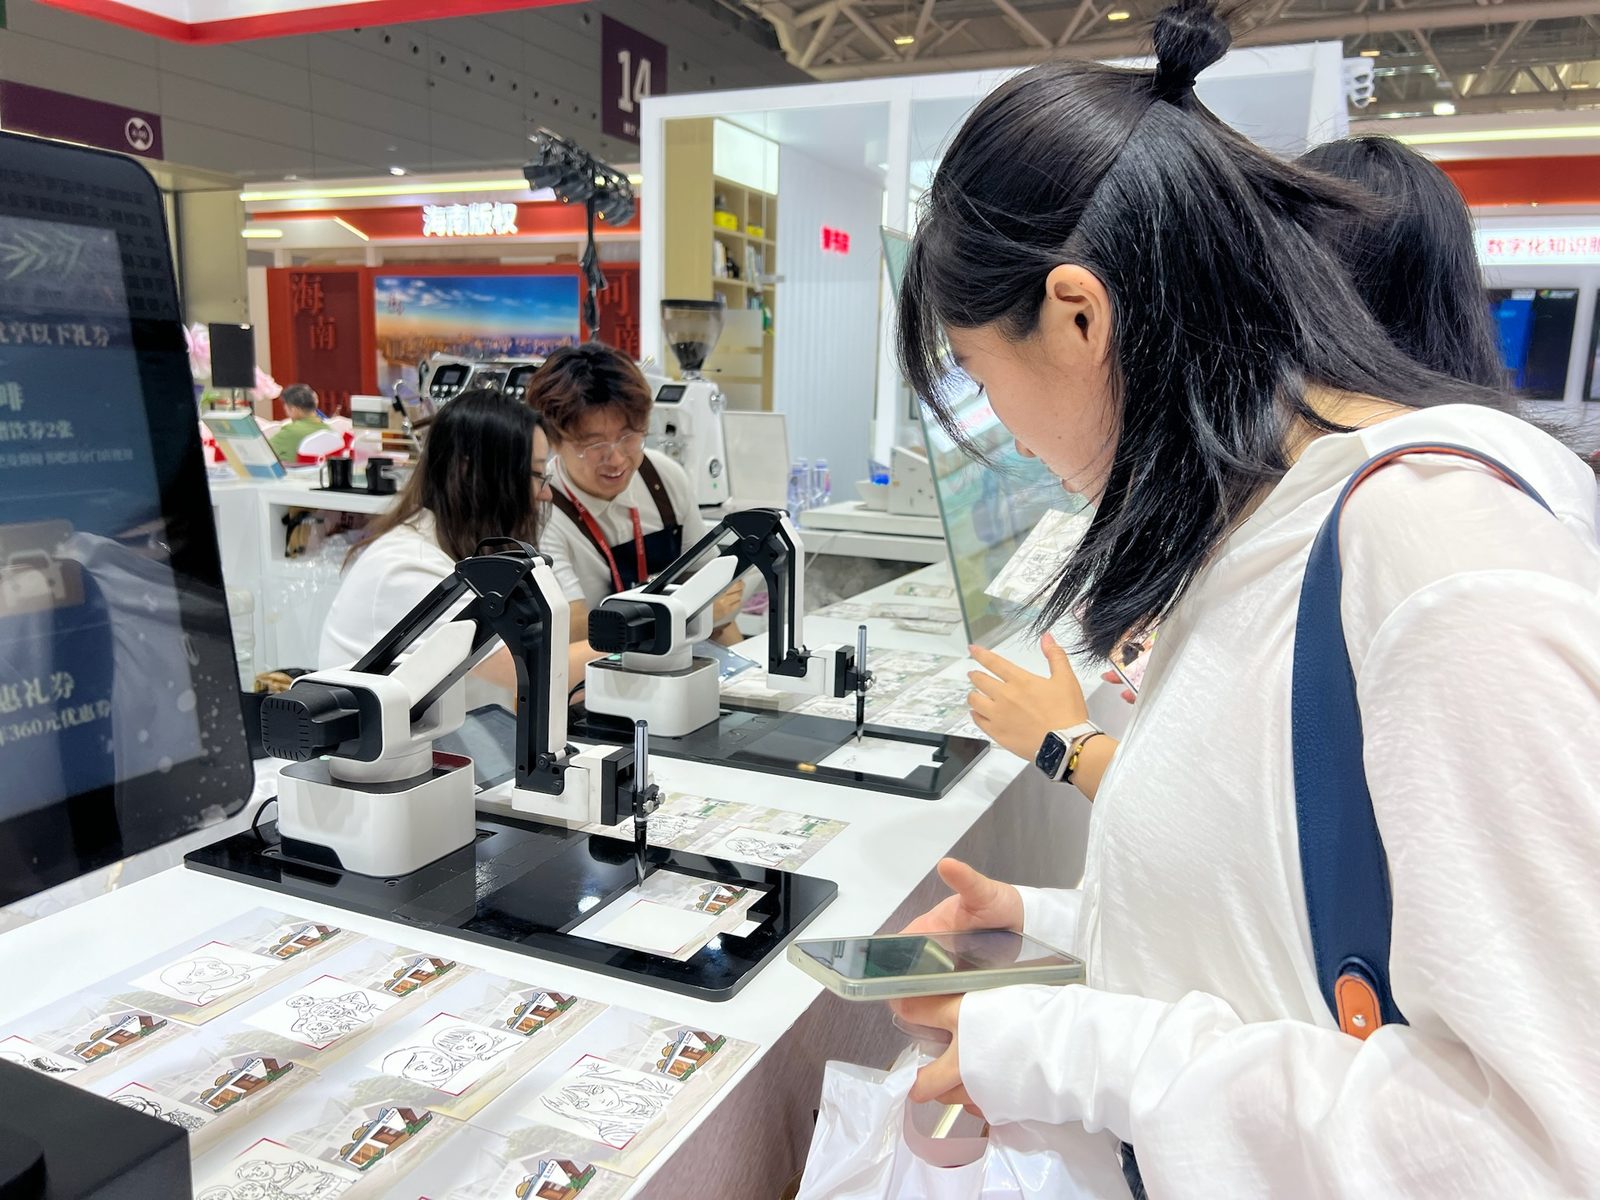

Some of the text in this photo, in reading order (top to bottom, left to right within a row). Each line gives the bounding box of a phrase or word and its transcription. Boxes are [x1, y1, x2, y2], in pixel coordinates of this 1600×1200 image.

[617, 49, 652, 114] 14
[422, 202, 518, 237] 海南版权
